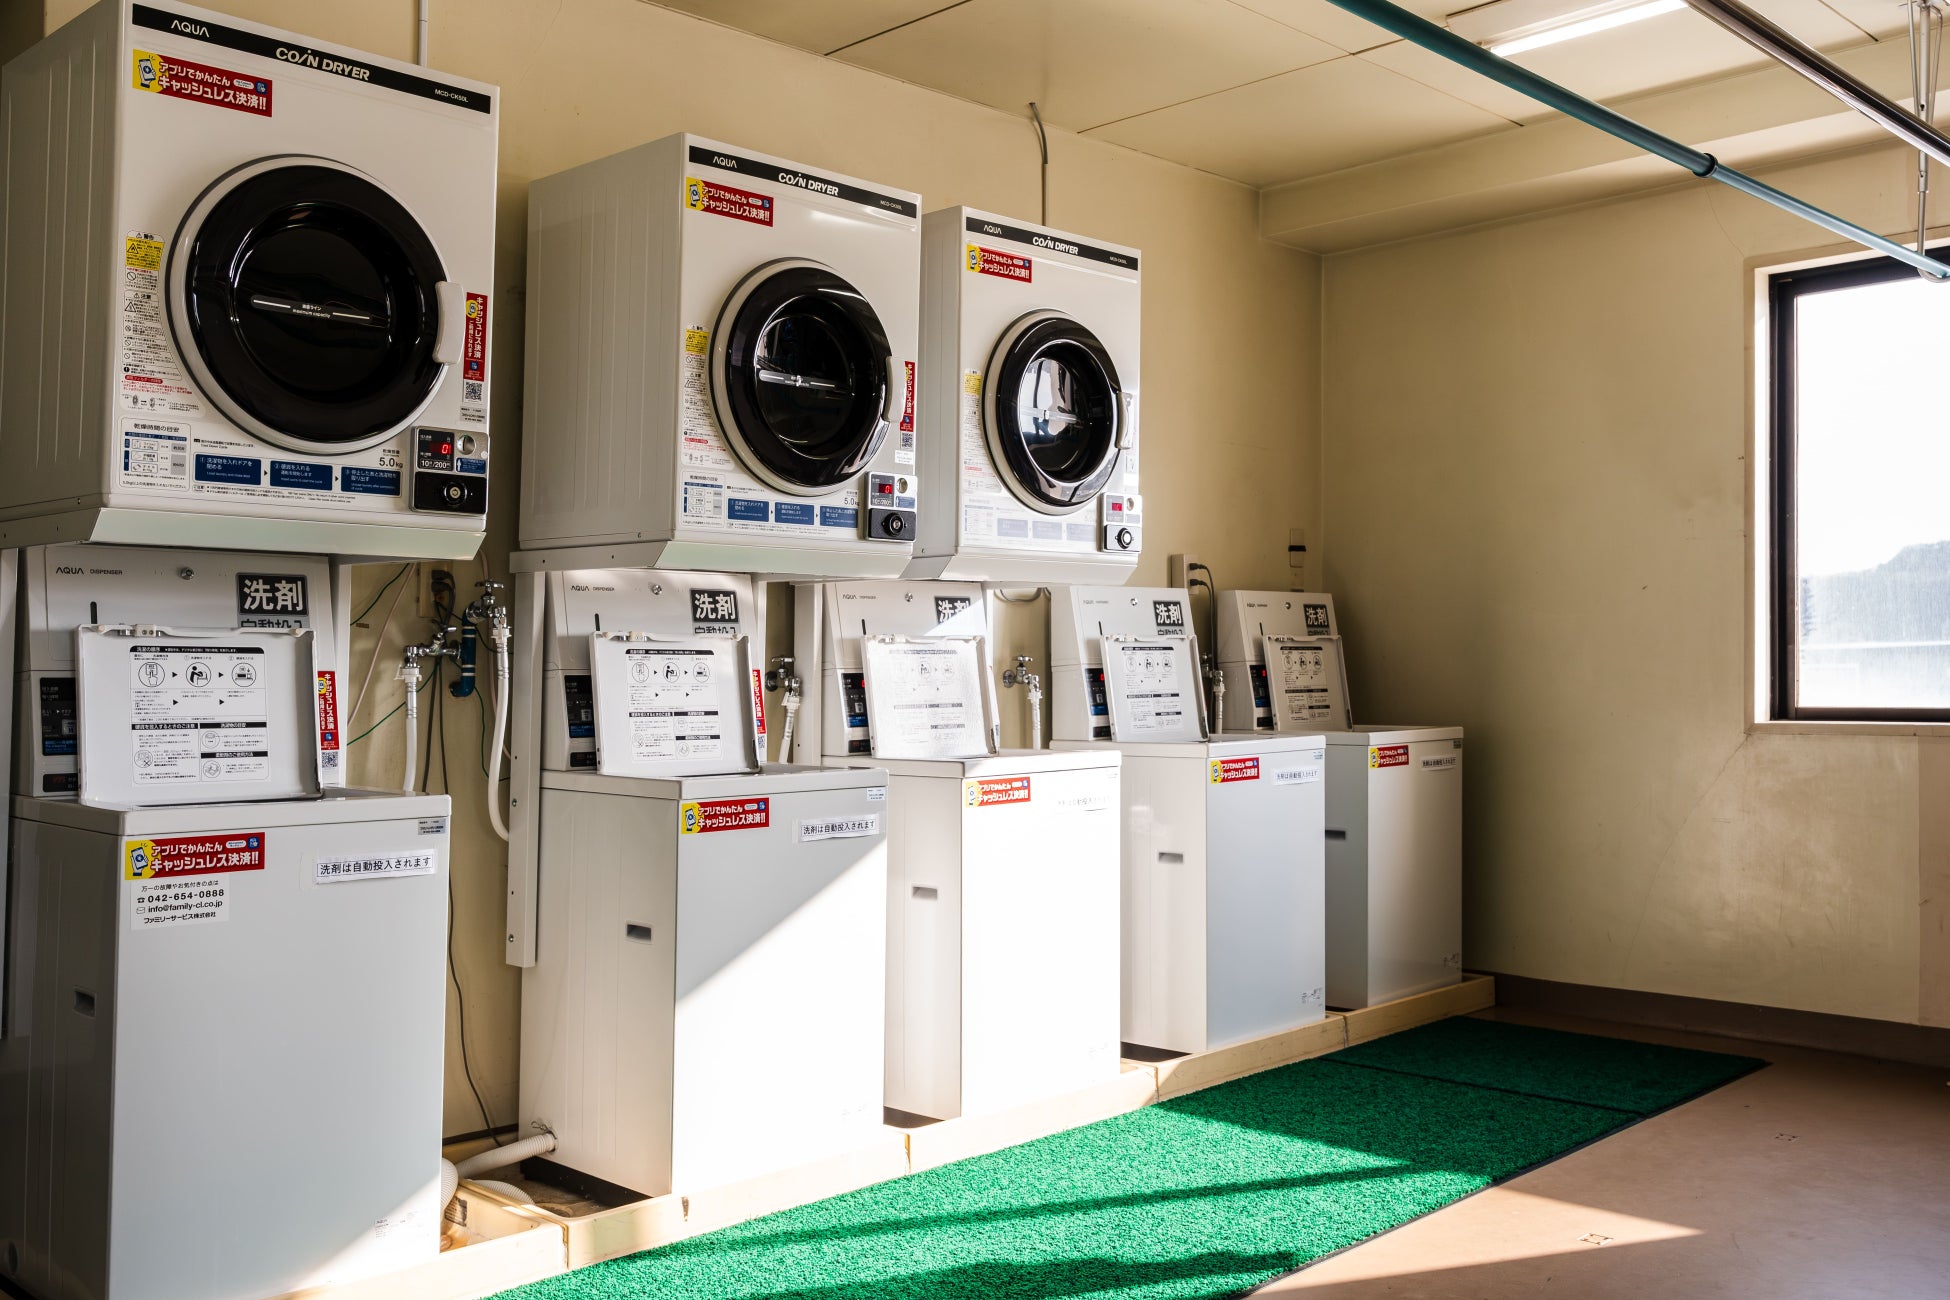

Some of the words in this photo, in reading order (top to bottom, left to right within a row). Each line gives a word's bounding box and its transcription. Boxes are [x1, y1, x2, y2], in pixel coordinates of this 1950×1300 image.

[171, 19, 210, 38] AQUA
[158, 61, 231, 87] アプリでかんたん
[322, 58, 370, 81] DRYER
[158, 75, 267, 110] キャッシュレス決済!!
[713, 156, 737, 168] AQUA
[702, 186, 747, 204] アプリでかんたん
[808, 180, 839, 197] DRYER
[702, 198, 770, 222] キャッシュレス決済!!
[984, 224, 1002, 234] AQUA
[1055, 241, 1079, 255] DRYER
[979, 252, 1012, 265] アプリでかんたん
[979, 262, 1030, 279] キャッシュレス決済!!
[474, 297, 483, 358] キャッシュレス決済
[134, 423, 180, 433] 乾燥時間の目安
[441, 444, 450, 455] 0
[56, 567, 84, 575] AQUA
[243, 579, 303, 611] 洗剤
[695, 594, 736, 620] 洗剤
[1156, 604, 1182, 624] 洗剤
[1306, 607, 1328, 625] 洗剤
[325, 674, 334, 729] キャッシュレス決済
[699, 804, 742, 815] アプリでかんたん
[698, 813, 766, 828] キャッシュレス決済!!
[803, 821, 875, 835] 洗剤は自動投入されます
[152, 842, 223, 856] アプリでかんたん
[151, 852, 259, 871] キャッシュレス決済!!
[320, 857, 431, 875] 洗剤は自動投入されます
[141, 880, 219, 892] 万一の故障やお気付きの点は
[148, 889, 225, 903] 042-654-0888
[148, 900, 223, 913] info@family-cl.co.jp
[143, 911, 216, 924] ファミリーサービス株式会社
